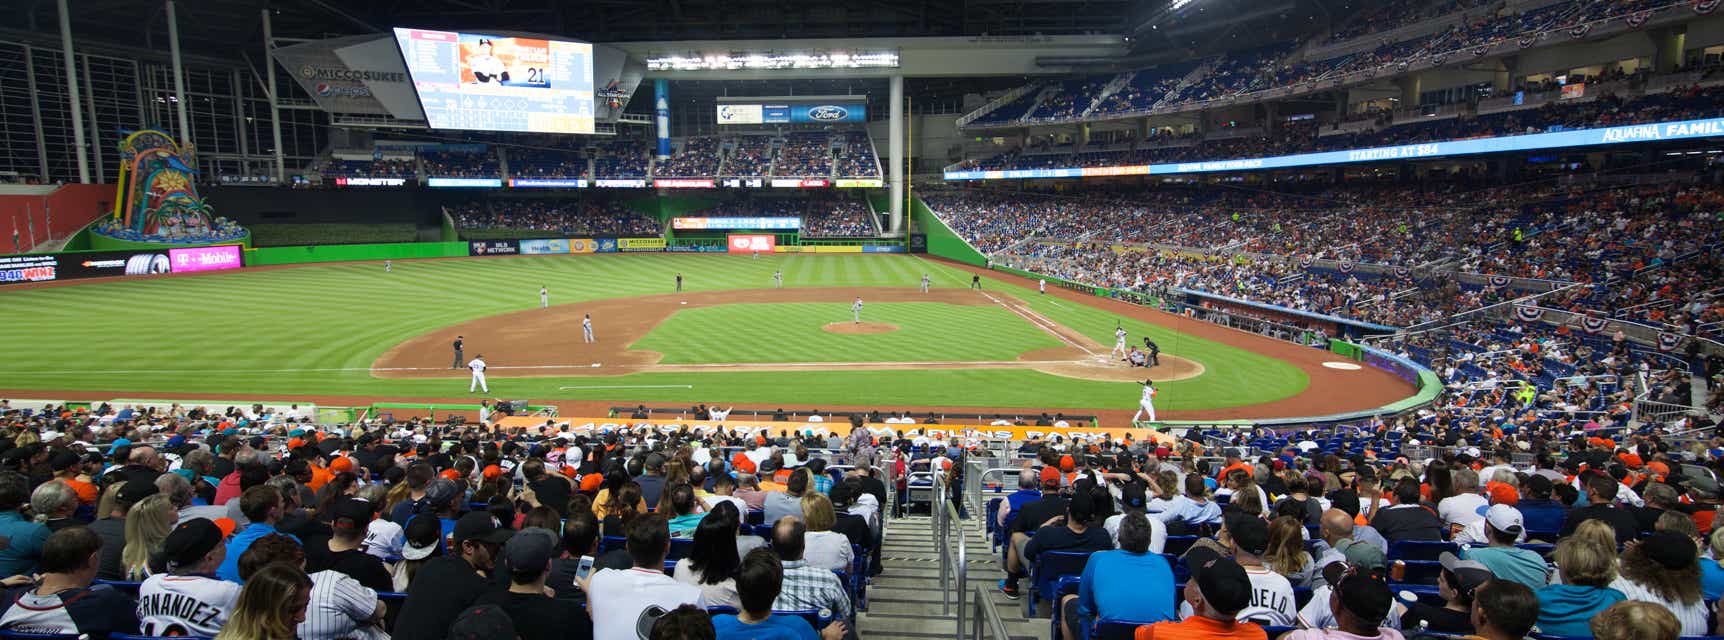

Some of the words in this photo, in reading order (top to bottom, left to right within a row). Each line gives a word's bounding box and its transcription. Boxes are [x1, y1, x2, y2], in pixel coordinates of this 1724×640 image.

[317, 68, 404, 82] MICCOSUKEE
[528, 67, 545, 83] 21
[815, 110, 840, 119] Ford
[1602, 124, 1661, 143] AQUAFINA
[1350, 147, 1398, 160] STARTING
[1401, 145, 1416, 156] AT
[1417, 143, 1438, 156] $84
[346, 178, 406, 186] MONSTER
[139, 593, 222, 628] RNANDEZ
